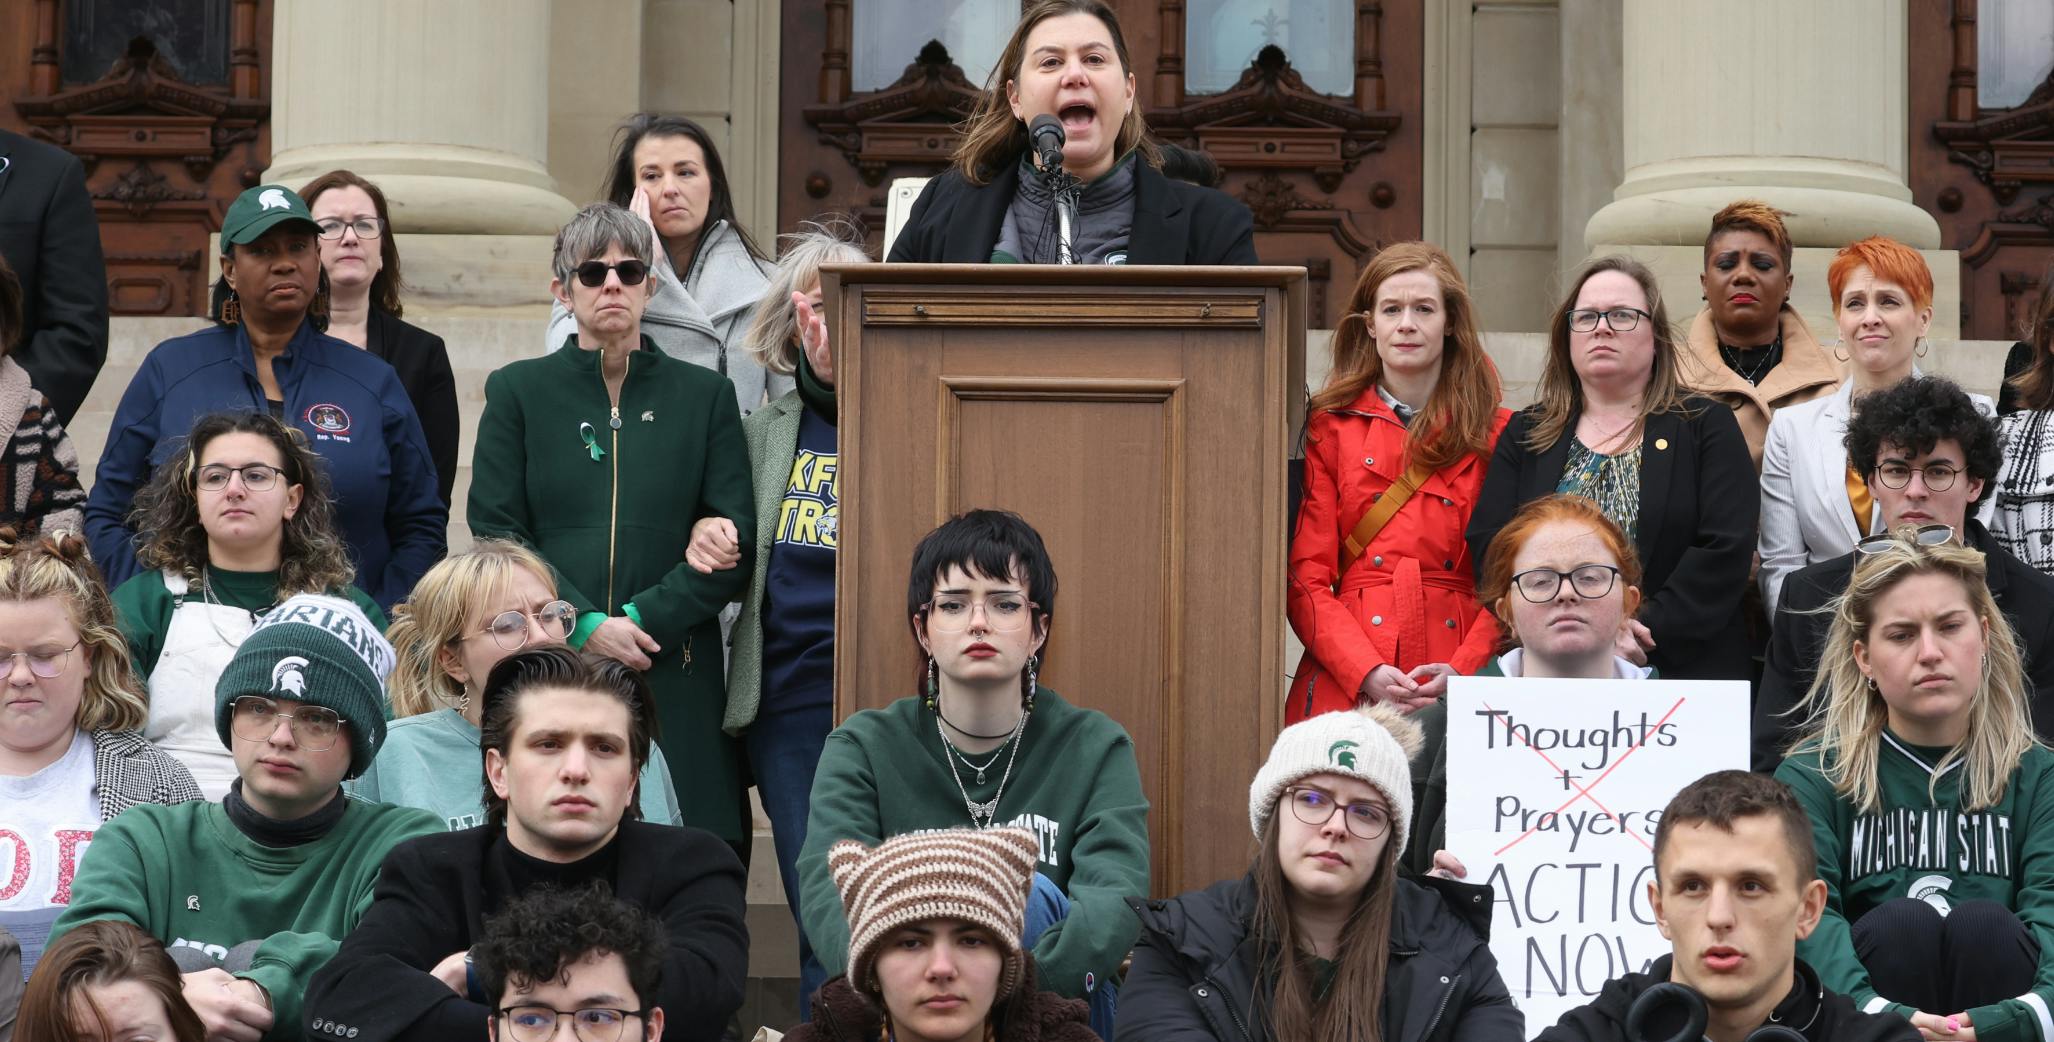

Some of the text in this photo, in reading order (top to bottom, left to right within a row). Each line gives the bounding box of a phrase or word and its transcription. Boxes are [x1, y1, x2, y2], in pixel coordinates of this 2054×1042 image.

[1475, 710, 1678, 770] Thoughts
[1554, 769, 1583, 791] +
[1495, 795, 1665, 853] Prayers
[1850, 808, 2010, 881] MICHIGAN STAT
[1486, 863, 1656, 928] ACTIO
